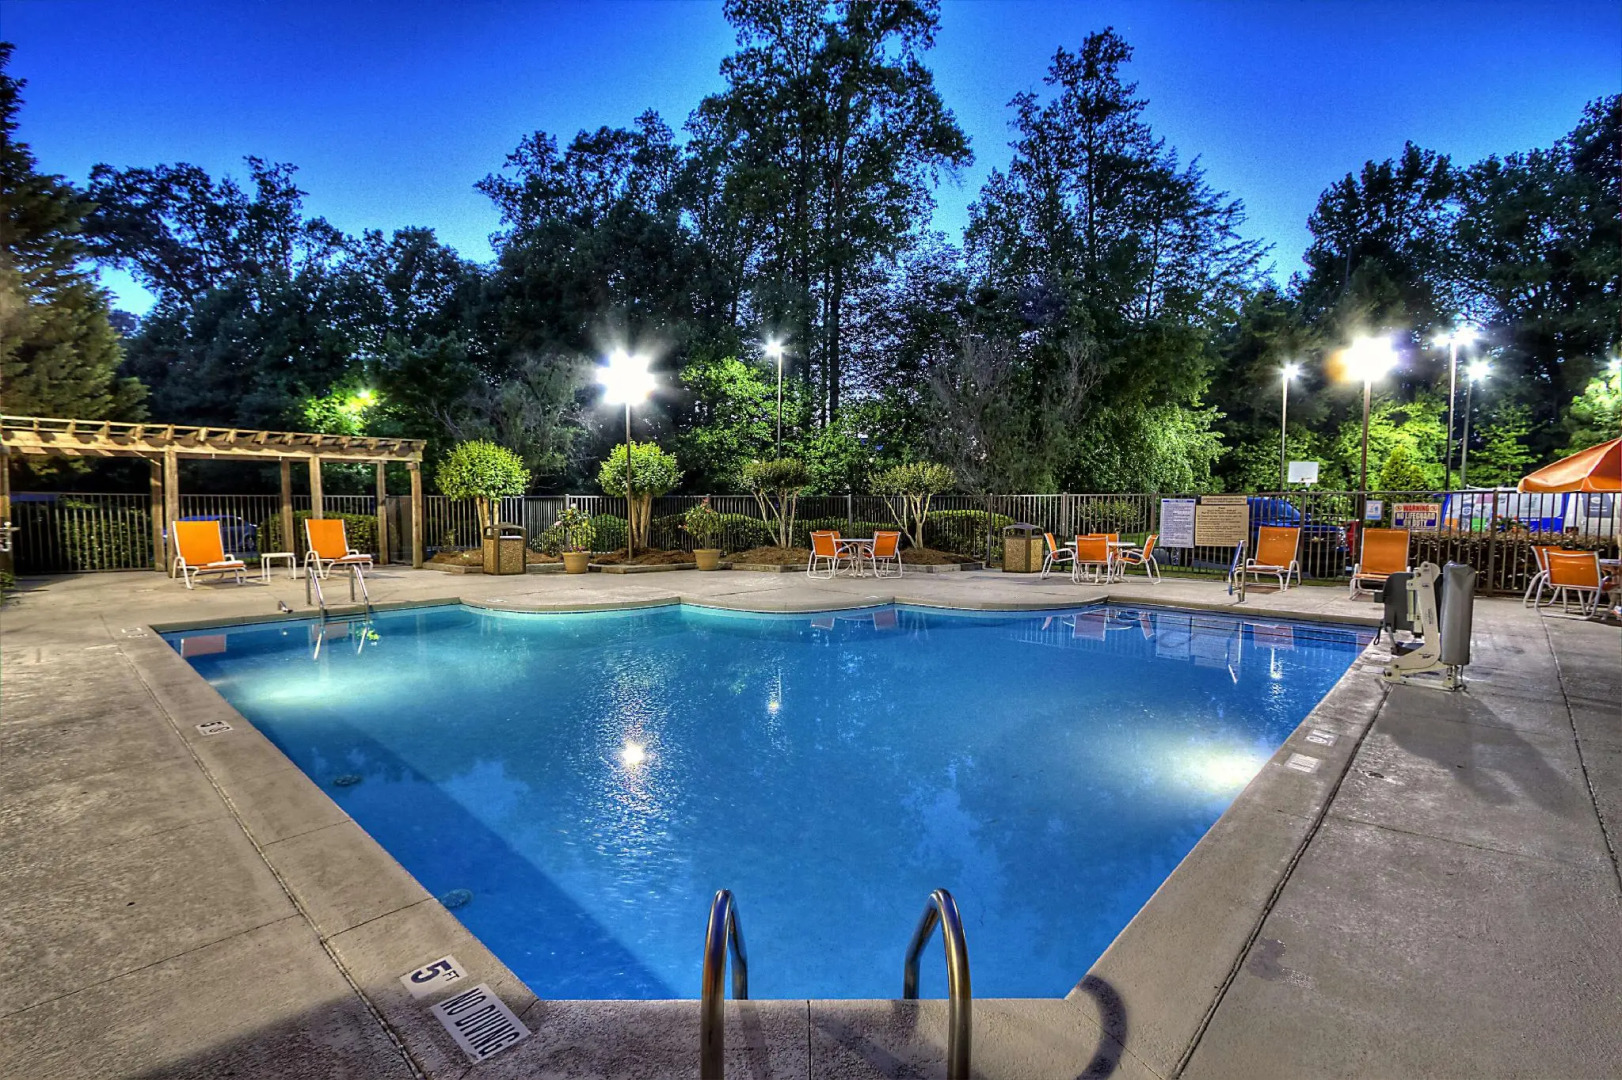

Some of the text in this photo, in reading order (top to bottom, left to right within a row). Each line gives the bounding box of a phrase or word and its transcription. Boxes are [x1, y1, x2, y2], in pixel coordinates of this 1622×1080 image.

[411, 960, 452, 983] 5
[440, 988, 521, 1057] NO DIVING
